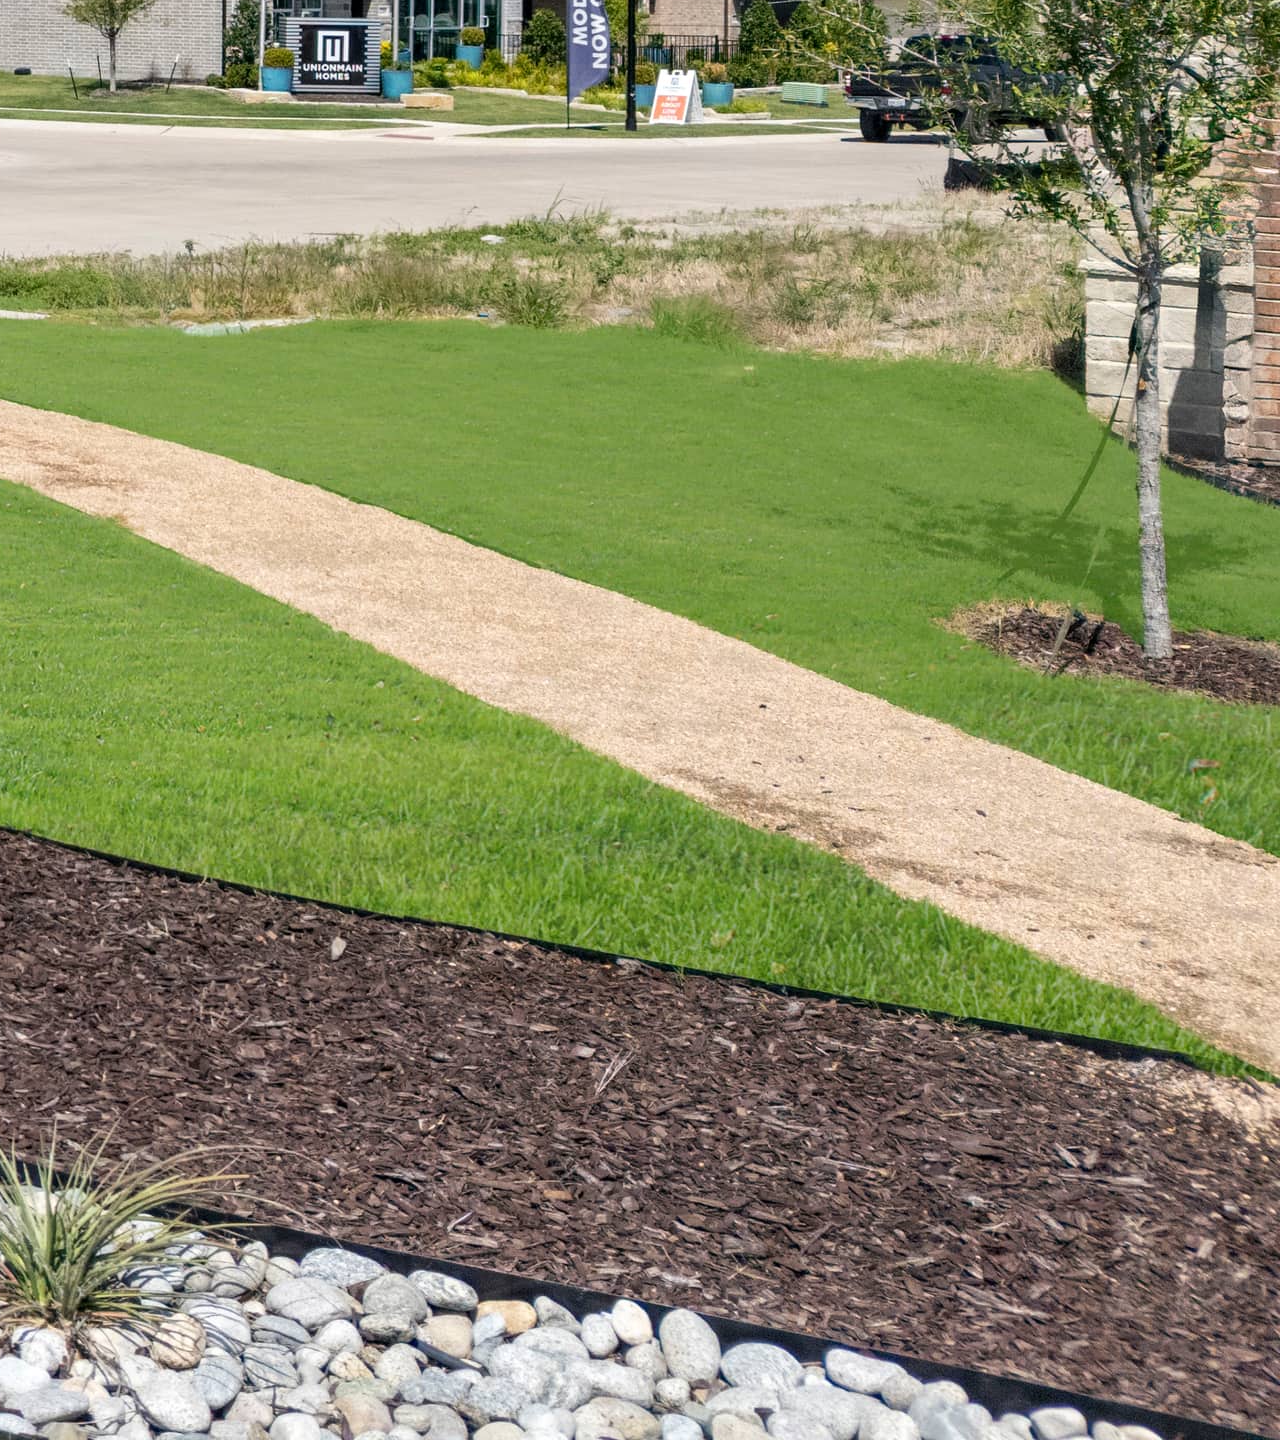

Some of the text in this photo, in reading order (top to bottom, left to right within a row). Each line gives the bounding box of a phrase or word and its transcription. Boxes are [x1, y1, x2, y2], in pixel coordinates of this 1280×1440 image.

[590, 13, 608, 69] NOW
[303, 63, 363, 72] UNIONMAIN
[315, 72, 350, 80] HOMES
